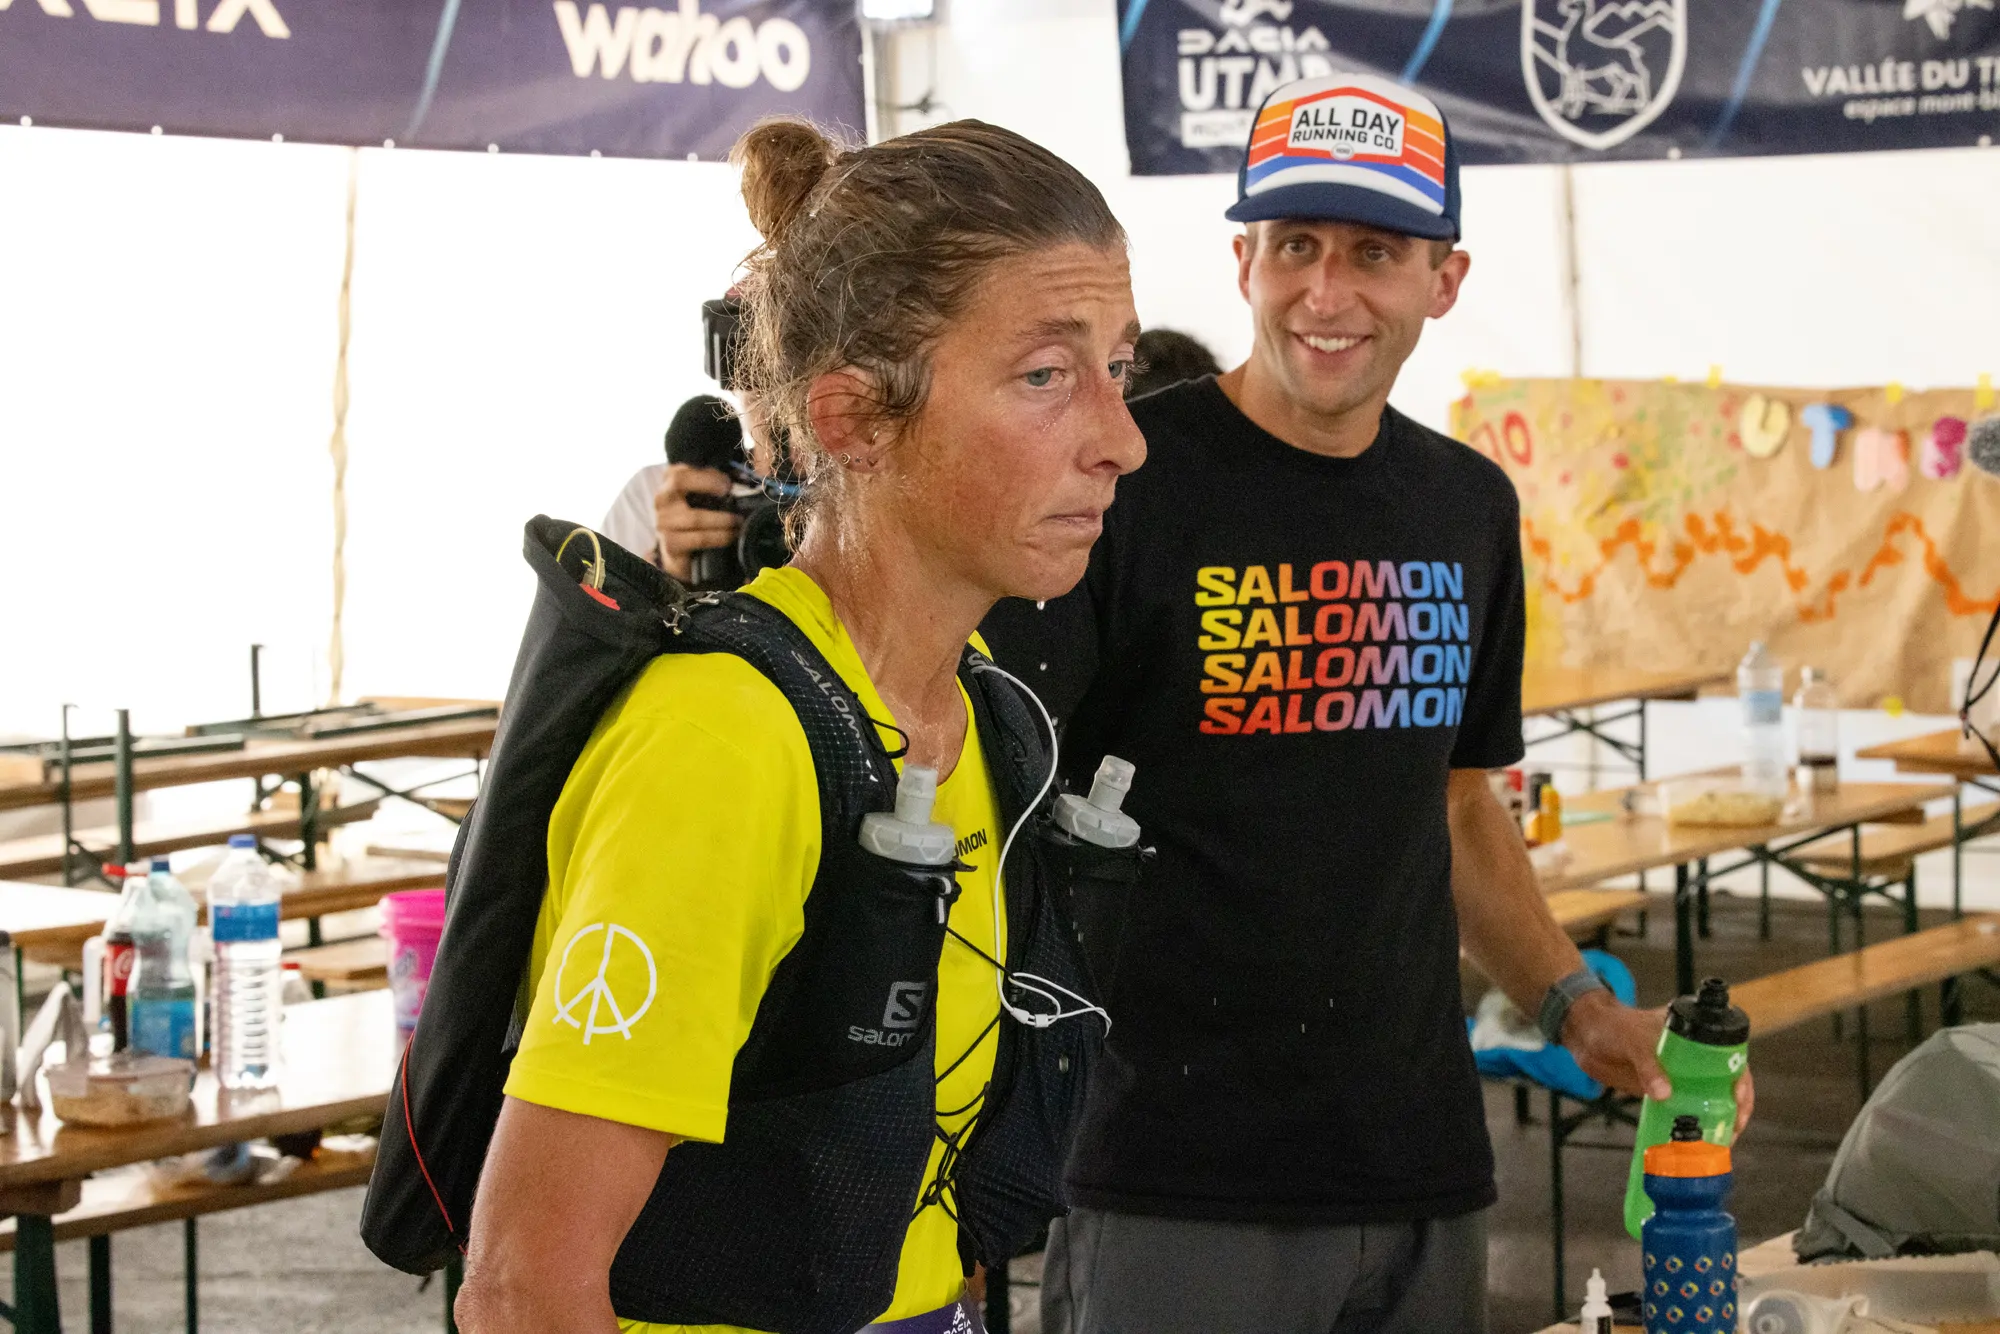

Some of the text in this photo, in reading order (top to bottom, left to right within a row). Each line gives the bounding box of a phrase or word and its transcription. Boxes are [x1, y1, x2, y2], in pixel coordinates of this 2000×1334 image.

[554, 0, 811, 92] wahoo
[1177, 26, 1331, 55] DACIA
[1801, 56, 1915, 97] VALLÉE
[1920, 58, 1970, 91] DU
[1291, 128, 1398, 153] RUNNING CO.
[1295, 107, 1400, 136] ALL DAY
[1195, 560, 1464, 607] SALOMON
[1197, 602, 1470, 650] SALOMON
[1200, 645, 1472, 694] SALOMON
[790, 650, 864, 751] SALOM
[1200, 688, 1467, 735] SALOMON
[954, 828, 988, 858] MON
